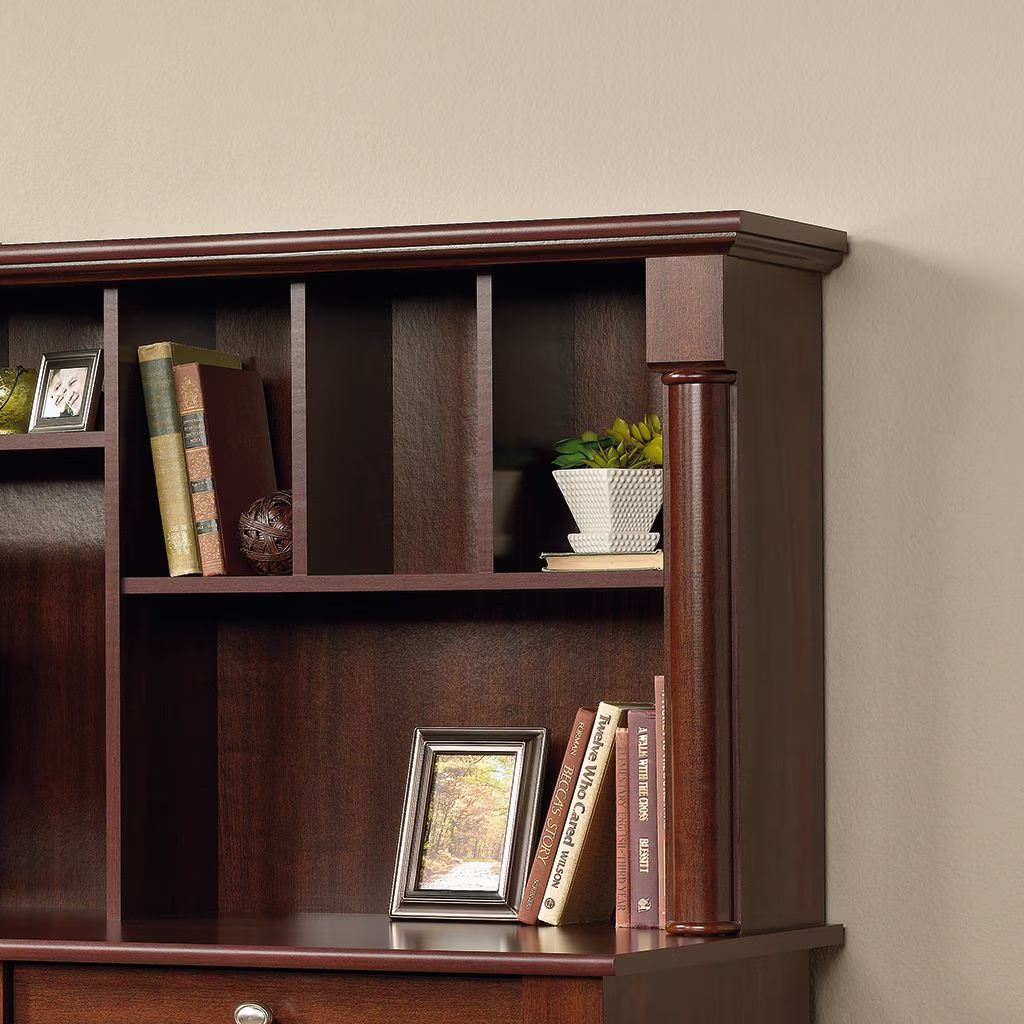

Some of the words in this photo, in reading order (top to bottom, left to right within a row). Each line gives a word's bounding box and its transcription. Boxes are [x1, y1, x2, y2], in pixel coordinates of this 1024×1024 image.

[570, 721, 585, 756] FORMAN
[587, 714, 612, 762] Twelve
[638, 726, 648, 734] A
[638, 734, 648, 758] WALK
[578, 762, 599, 800] Who
[617, 747, 628, 807] ELEMENTARY
[638, 758, 649, 781] WITH
[551, 764, 574, 817] BECCA'S
[638, 781, 649, 797] THE
[562, 802, 585, 848] Cared
[638, 797, 649, 822] CROSS
[537, 817, 558, 867] STORY
[550, 850, 570, 889] WILSON
[617, 886, 627, 912] YEAR
